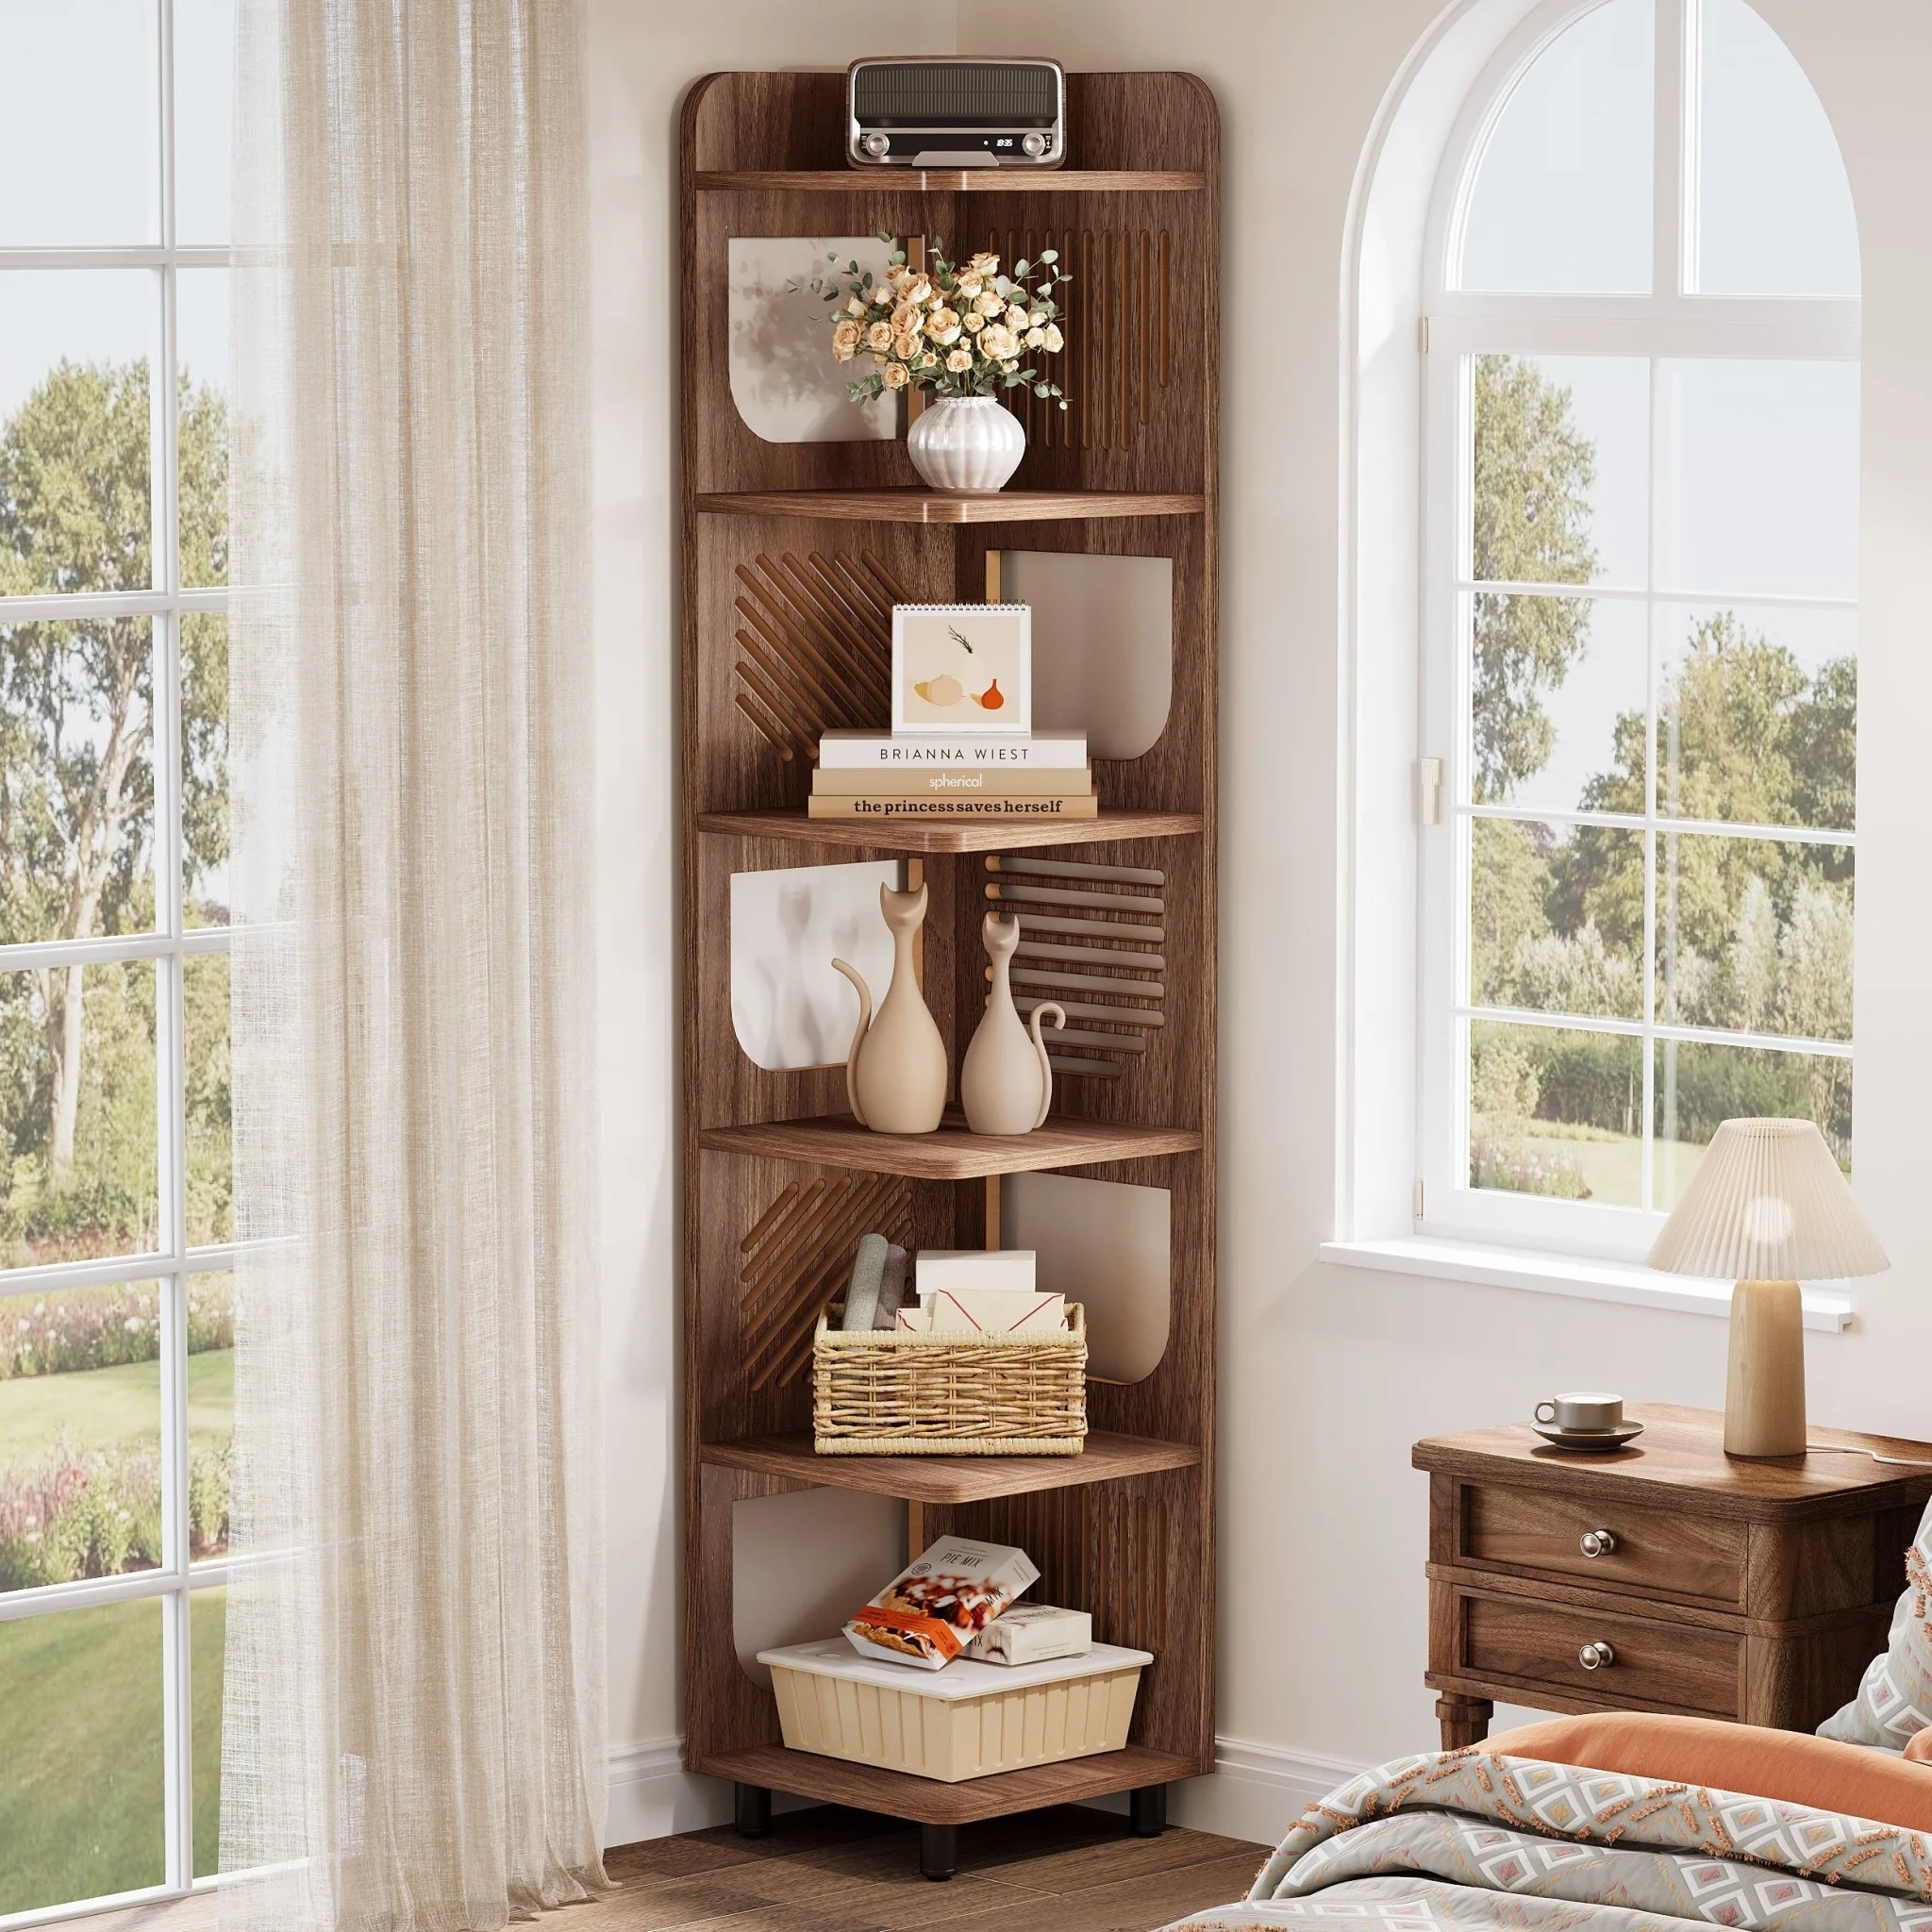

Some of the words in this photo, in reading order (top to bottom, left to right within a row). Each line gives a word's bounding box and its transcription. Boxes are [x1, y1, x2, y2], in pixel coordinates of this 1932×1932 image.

[880, 748, 965, 760] BRIANNA
[974, 748, 1029, 760] WIEST
[928, 773, 983, 791] spherical
[854, 800, 882, 812] the
[884, 800, 955, 816] princess
[957, 802, 1002, 813] saves
[1004, 800, 1063, 813] herself
[940, 1552, 962, 1564] PIE
[960, 1556, 984, 1569] MIX
[985, 1586, 1005, 1607] MIX
